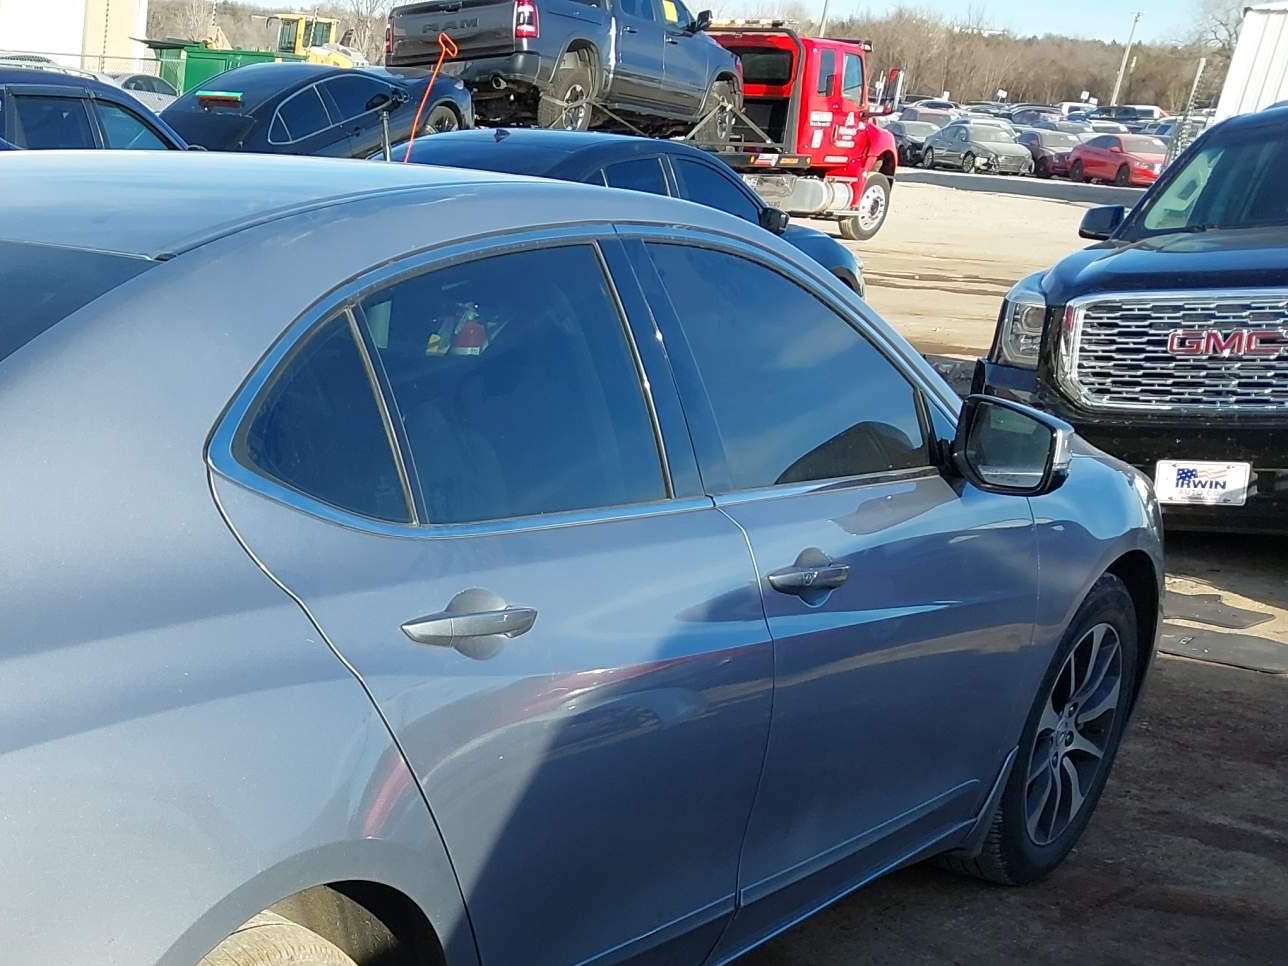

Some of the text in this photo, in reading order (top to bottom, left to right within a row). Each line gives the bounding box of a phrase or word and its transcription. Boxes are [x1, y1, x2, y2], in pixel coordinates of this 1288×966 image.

[422, 17, 479, 33] RAM
[1167, 328, 1283, 358] GMC
[1175, 479, 1227, 490] IRWIN
